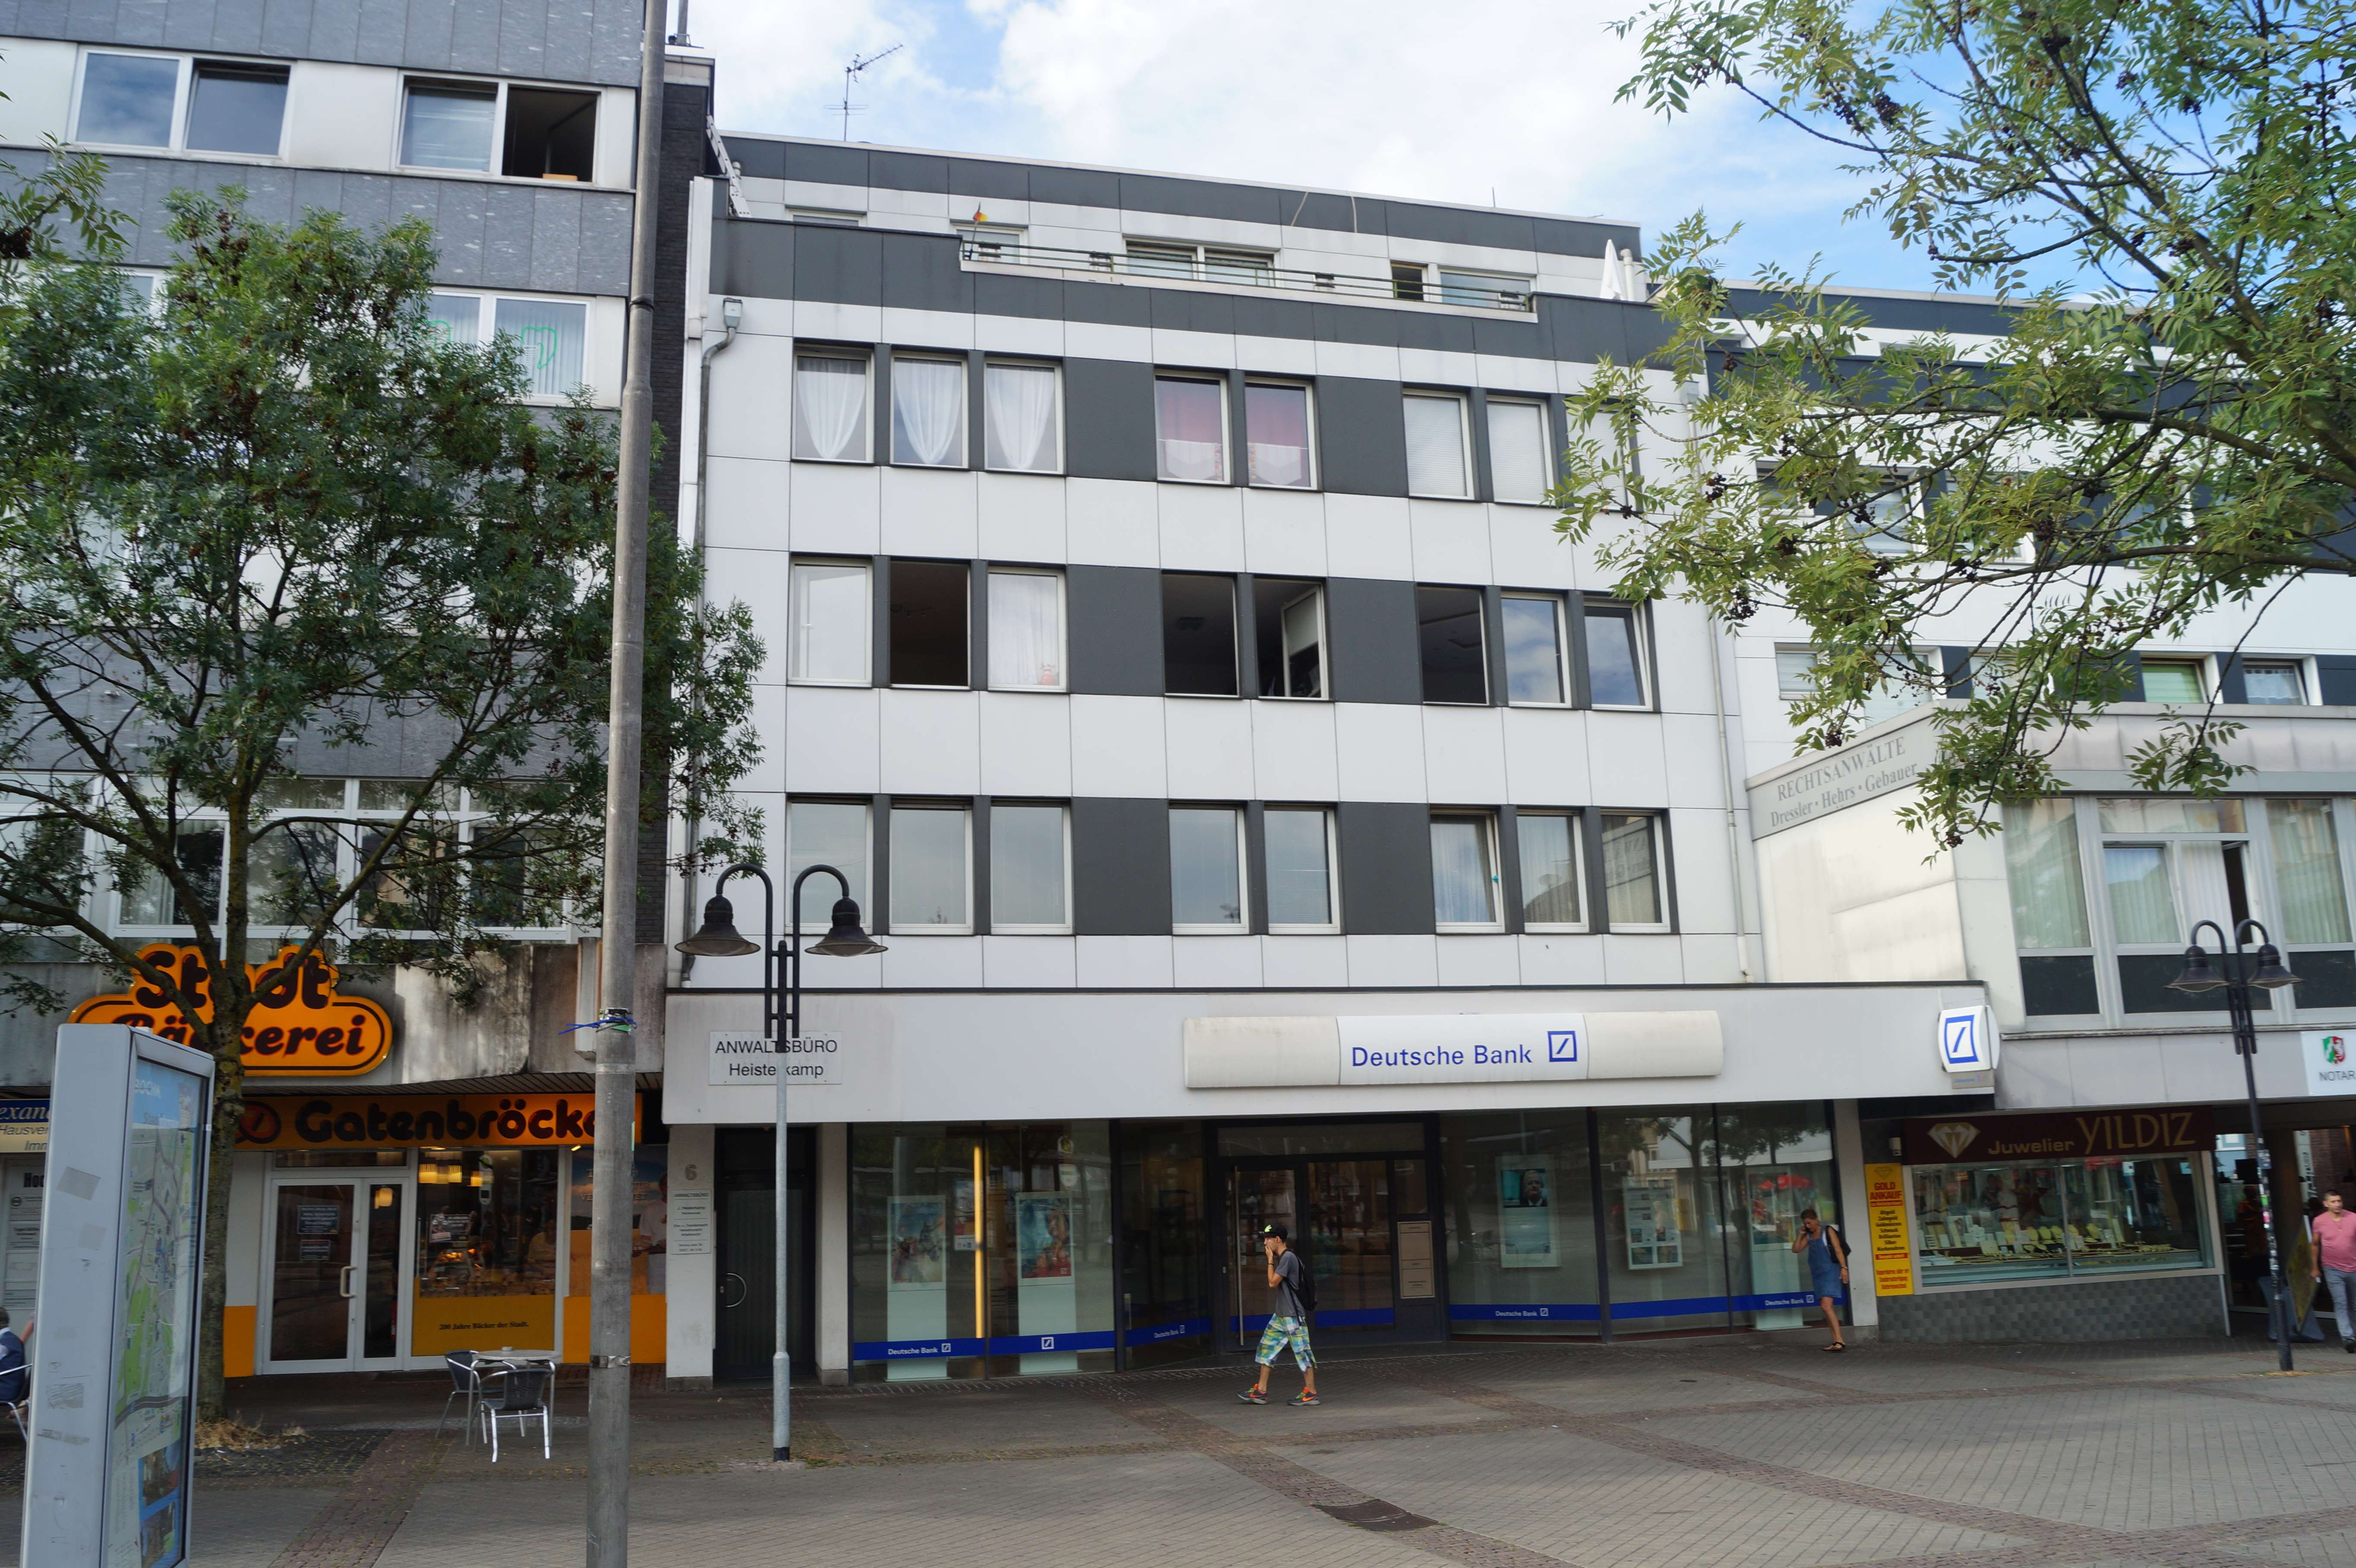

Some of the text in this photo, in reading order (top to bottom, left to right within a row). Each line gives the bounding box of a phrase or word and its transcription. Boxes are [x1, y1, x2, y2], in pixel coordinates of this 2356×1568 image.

[1777, 737, 1906, 801] RECHTSANWÄLTE
[1770, 762, 1918, 827] Dressler Hehrs Gebauer
[1352, 1044, 1533, 1067] Deutsche Bank
[729, 1063, 823, 1078] Heistekamp
[2318, 1071, 2356, 1081] NOTAR
[1988, 1113, 2197, 1155] Juwelier YILDIZ
[685, 1164, 697, 1181] 6
[1875, 1182, 1896, 1191] GOLD
[1870, 1191, 1902, 1200] ANKAUF
